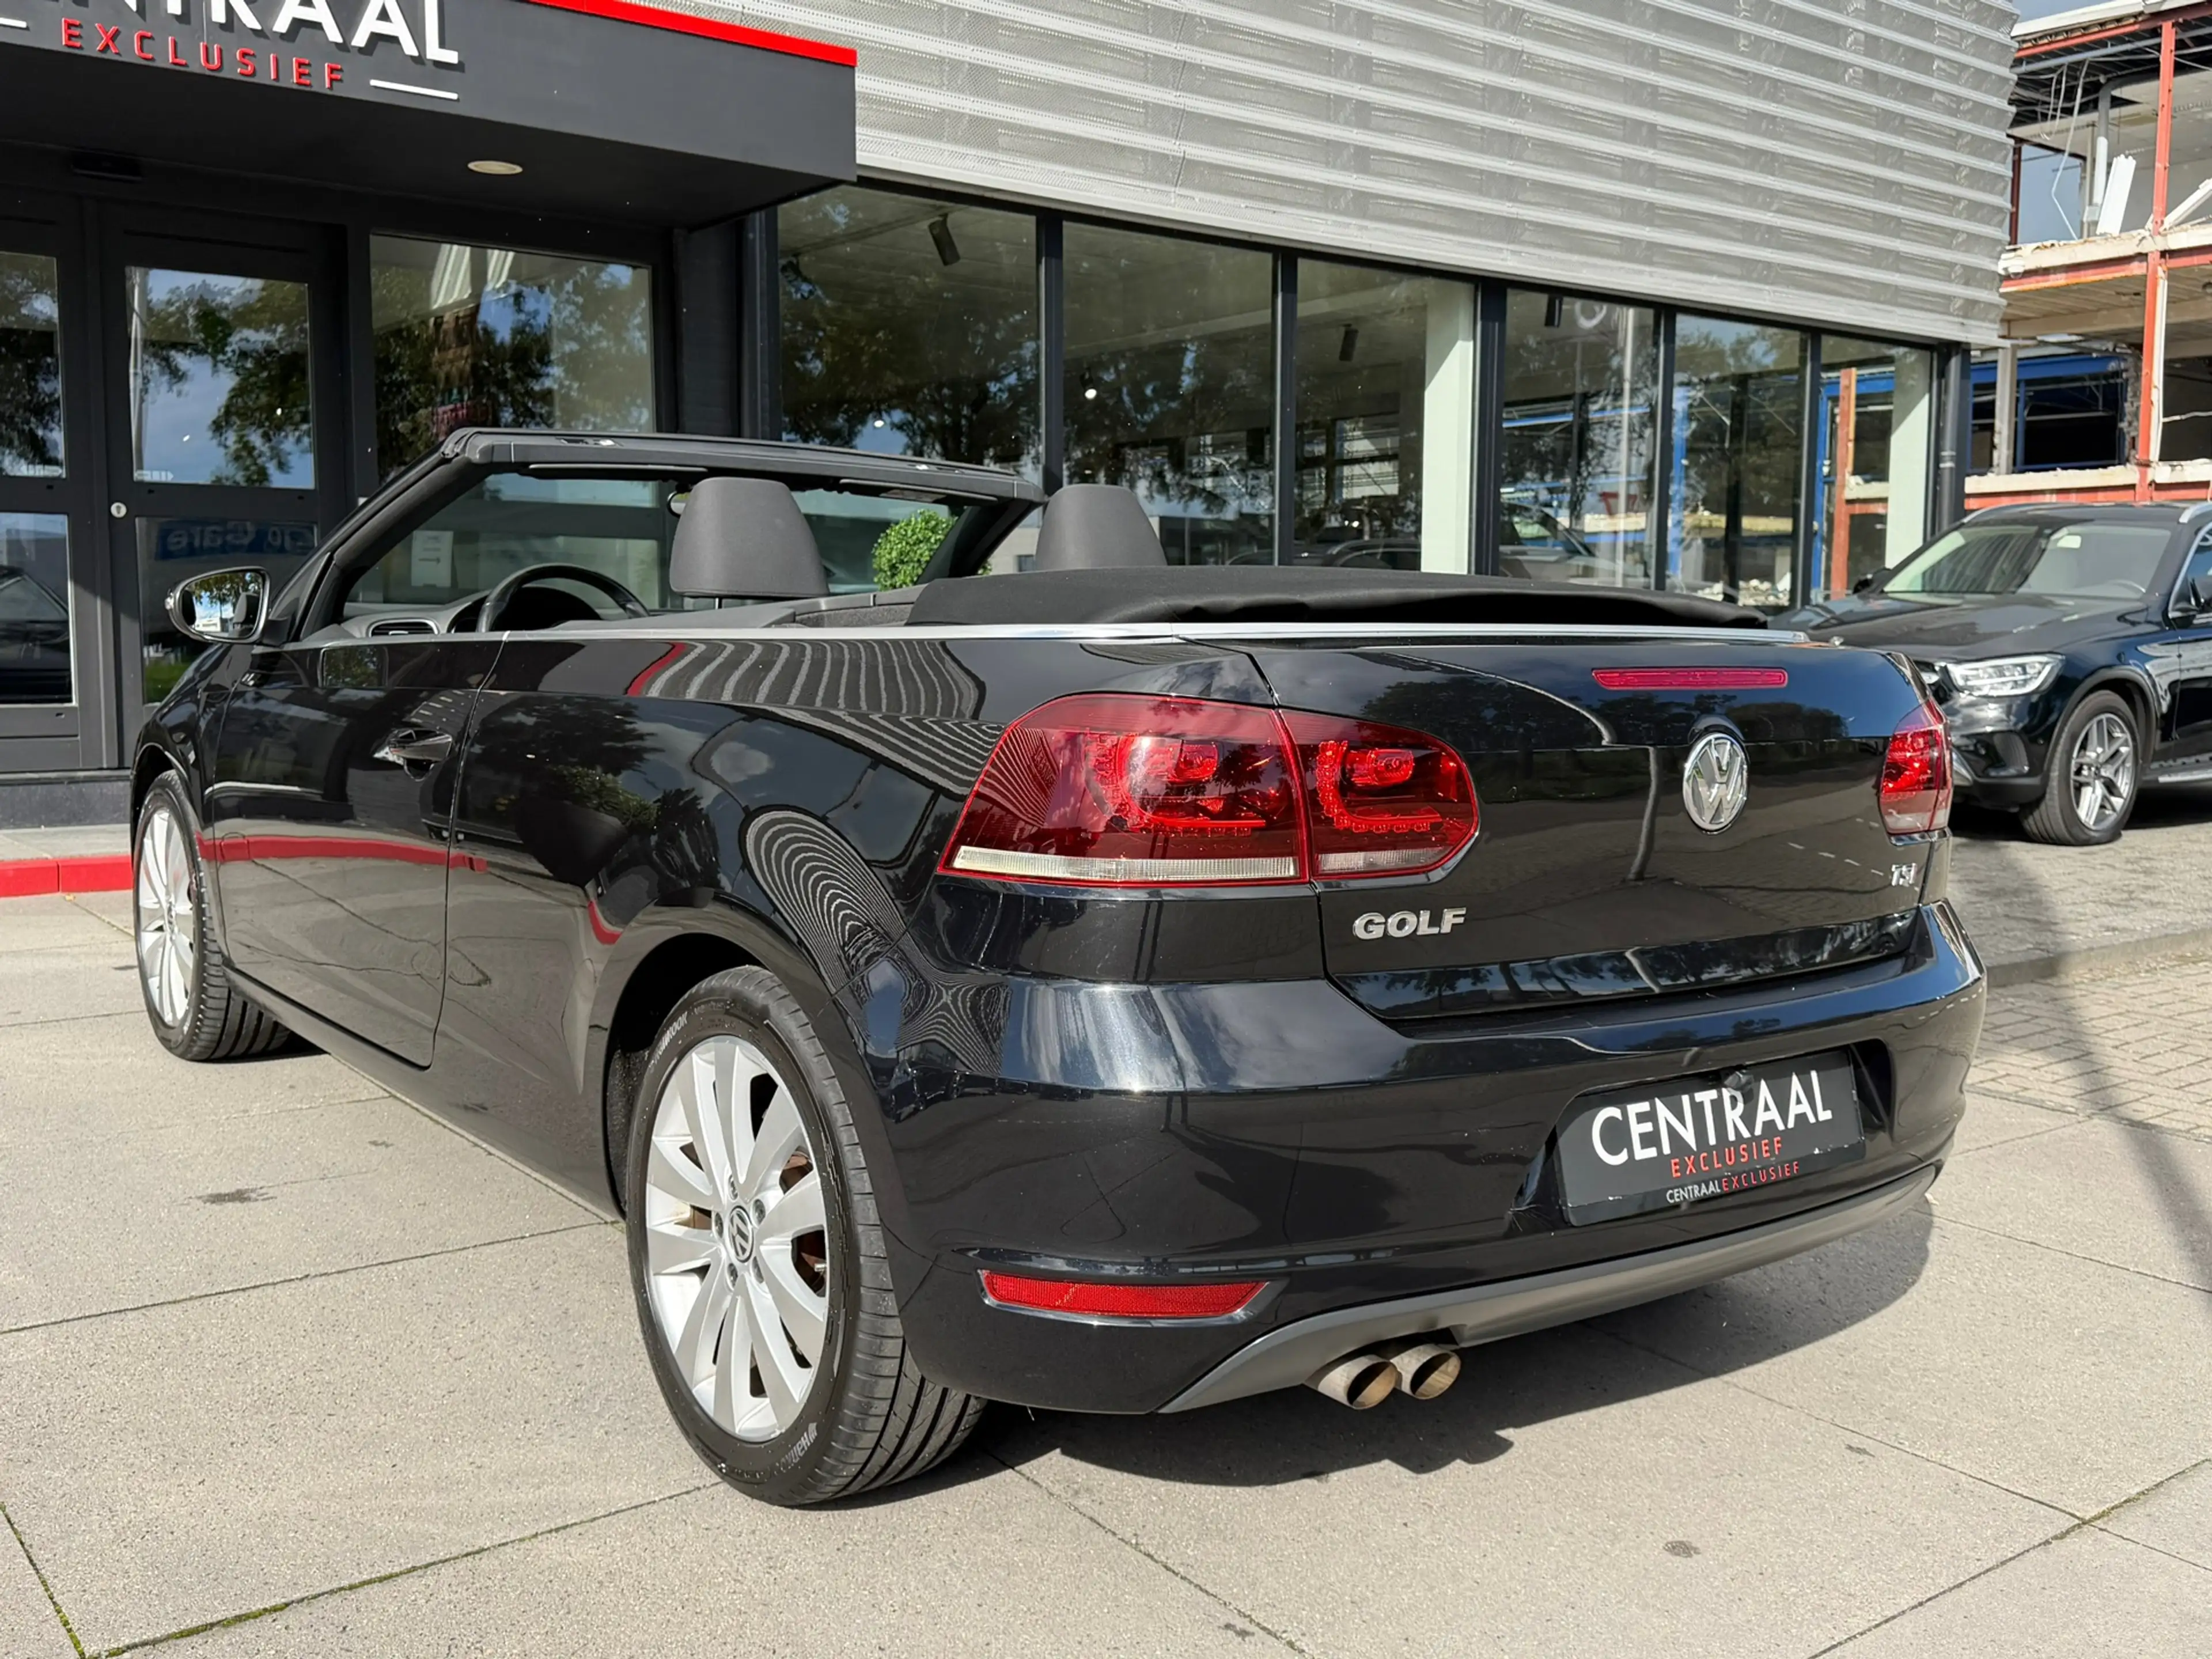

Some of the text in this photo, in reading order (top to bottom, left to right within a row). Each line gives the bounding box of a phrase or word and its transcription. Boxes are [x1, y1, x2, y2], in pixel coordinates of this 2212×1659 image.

[62, 17, 343, 89] EXCLUSIEF
[1353, 907, 1467, 940] GOLF
[1591, 1069, 1833, 1166] CENTRAAL
[1671, 1136, 1783, 1179] EXCLUSIEF
